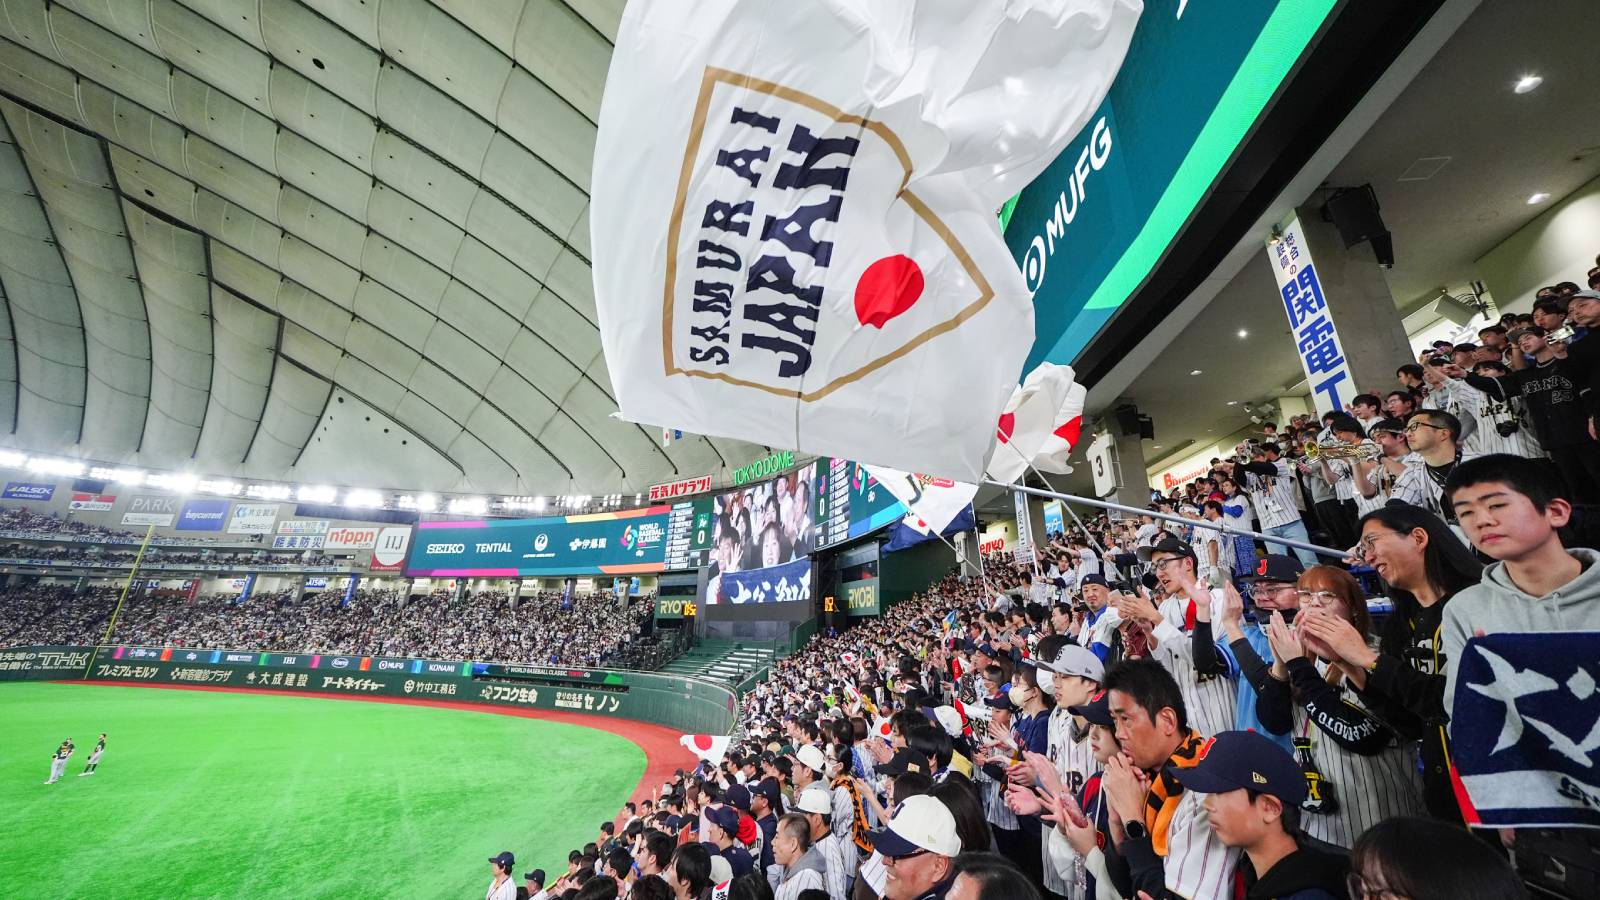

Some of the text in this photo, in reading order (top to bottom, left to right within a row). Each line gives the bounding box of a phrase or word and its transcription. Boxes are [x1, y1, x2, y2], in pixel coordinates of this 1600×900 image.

[1045, 115, 1112, 256] MUFG
[690, 106, 780, 367] SAMURAI
[741, 123, 860, 379] JAPAN
[733, 449, 795, 485] TOKYO DOME
[1095, 455, 1104, 478] 3
[15, 485, 53, 495] ALSOK
[649, 477, 711, 499] 元気ハツラツ!
[131, 497, 176, 513] PARK
[819, 498, 825, 516] 0
[638, 528, 665, 537] BASEBALL
[639, 522, 659, 531] WORLD
[273, 536, 322, 548] 能美防災
[329, 528, 375, 545] nippn
[581, 537, 607, 550] 伊藤園
[637, 535, 661, 543] CLASSIC
[697, 530, 705, 544] 0
[426, 543, 465, 554] SEIKO
[475, 542, 512, 553] TENTIAL
[1256, 559, 1268, 576] J
[848, 586, 875, 609] RYOBI
[37, 652, 91, 666] THK
[429, 663, 455, 672] KONAMI
[527, 668, 548, 676] BASEBALL
[258, 671, 309, 687] 大成建設
[322, 676, 385, 691] アートネイチャー
[416, 681, 457, 695] 竹中工務店
[493, 686, 538, 703] フコク生命
[584, 693, 620, 713] セノン
